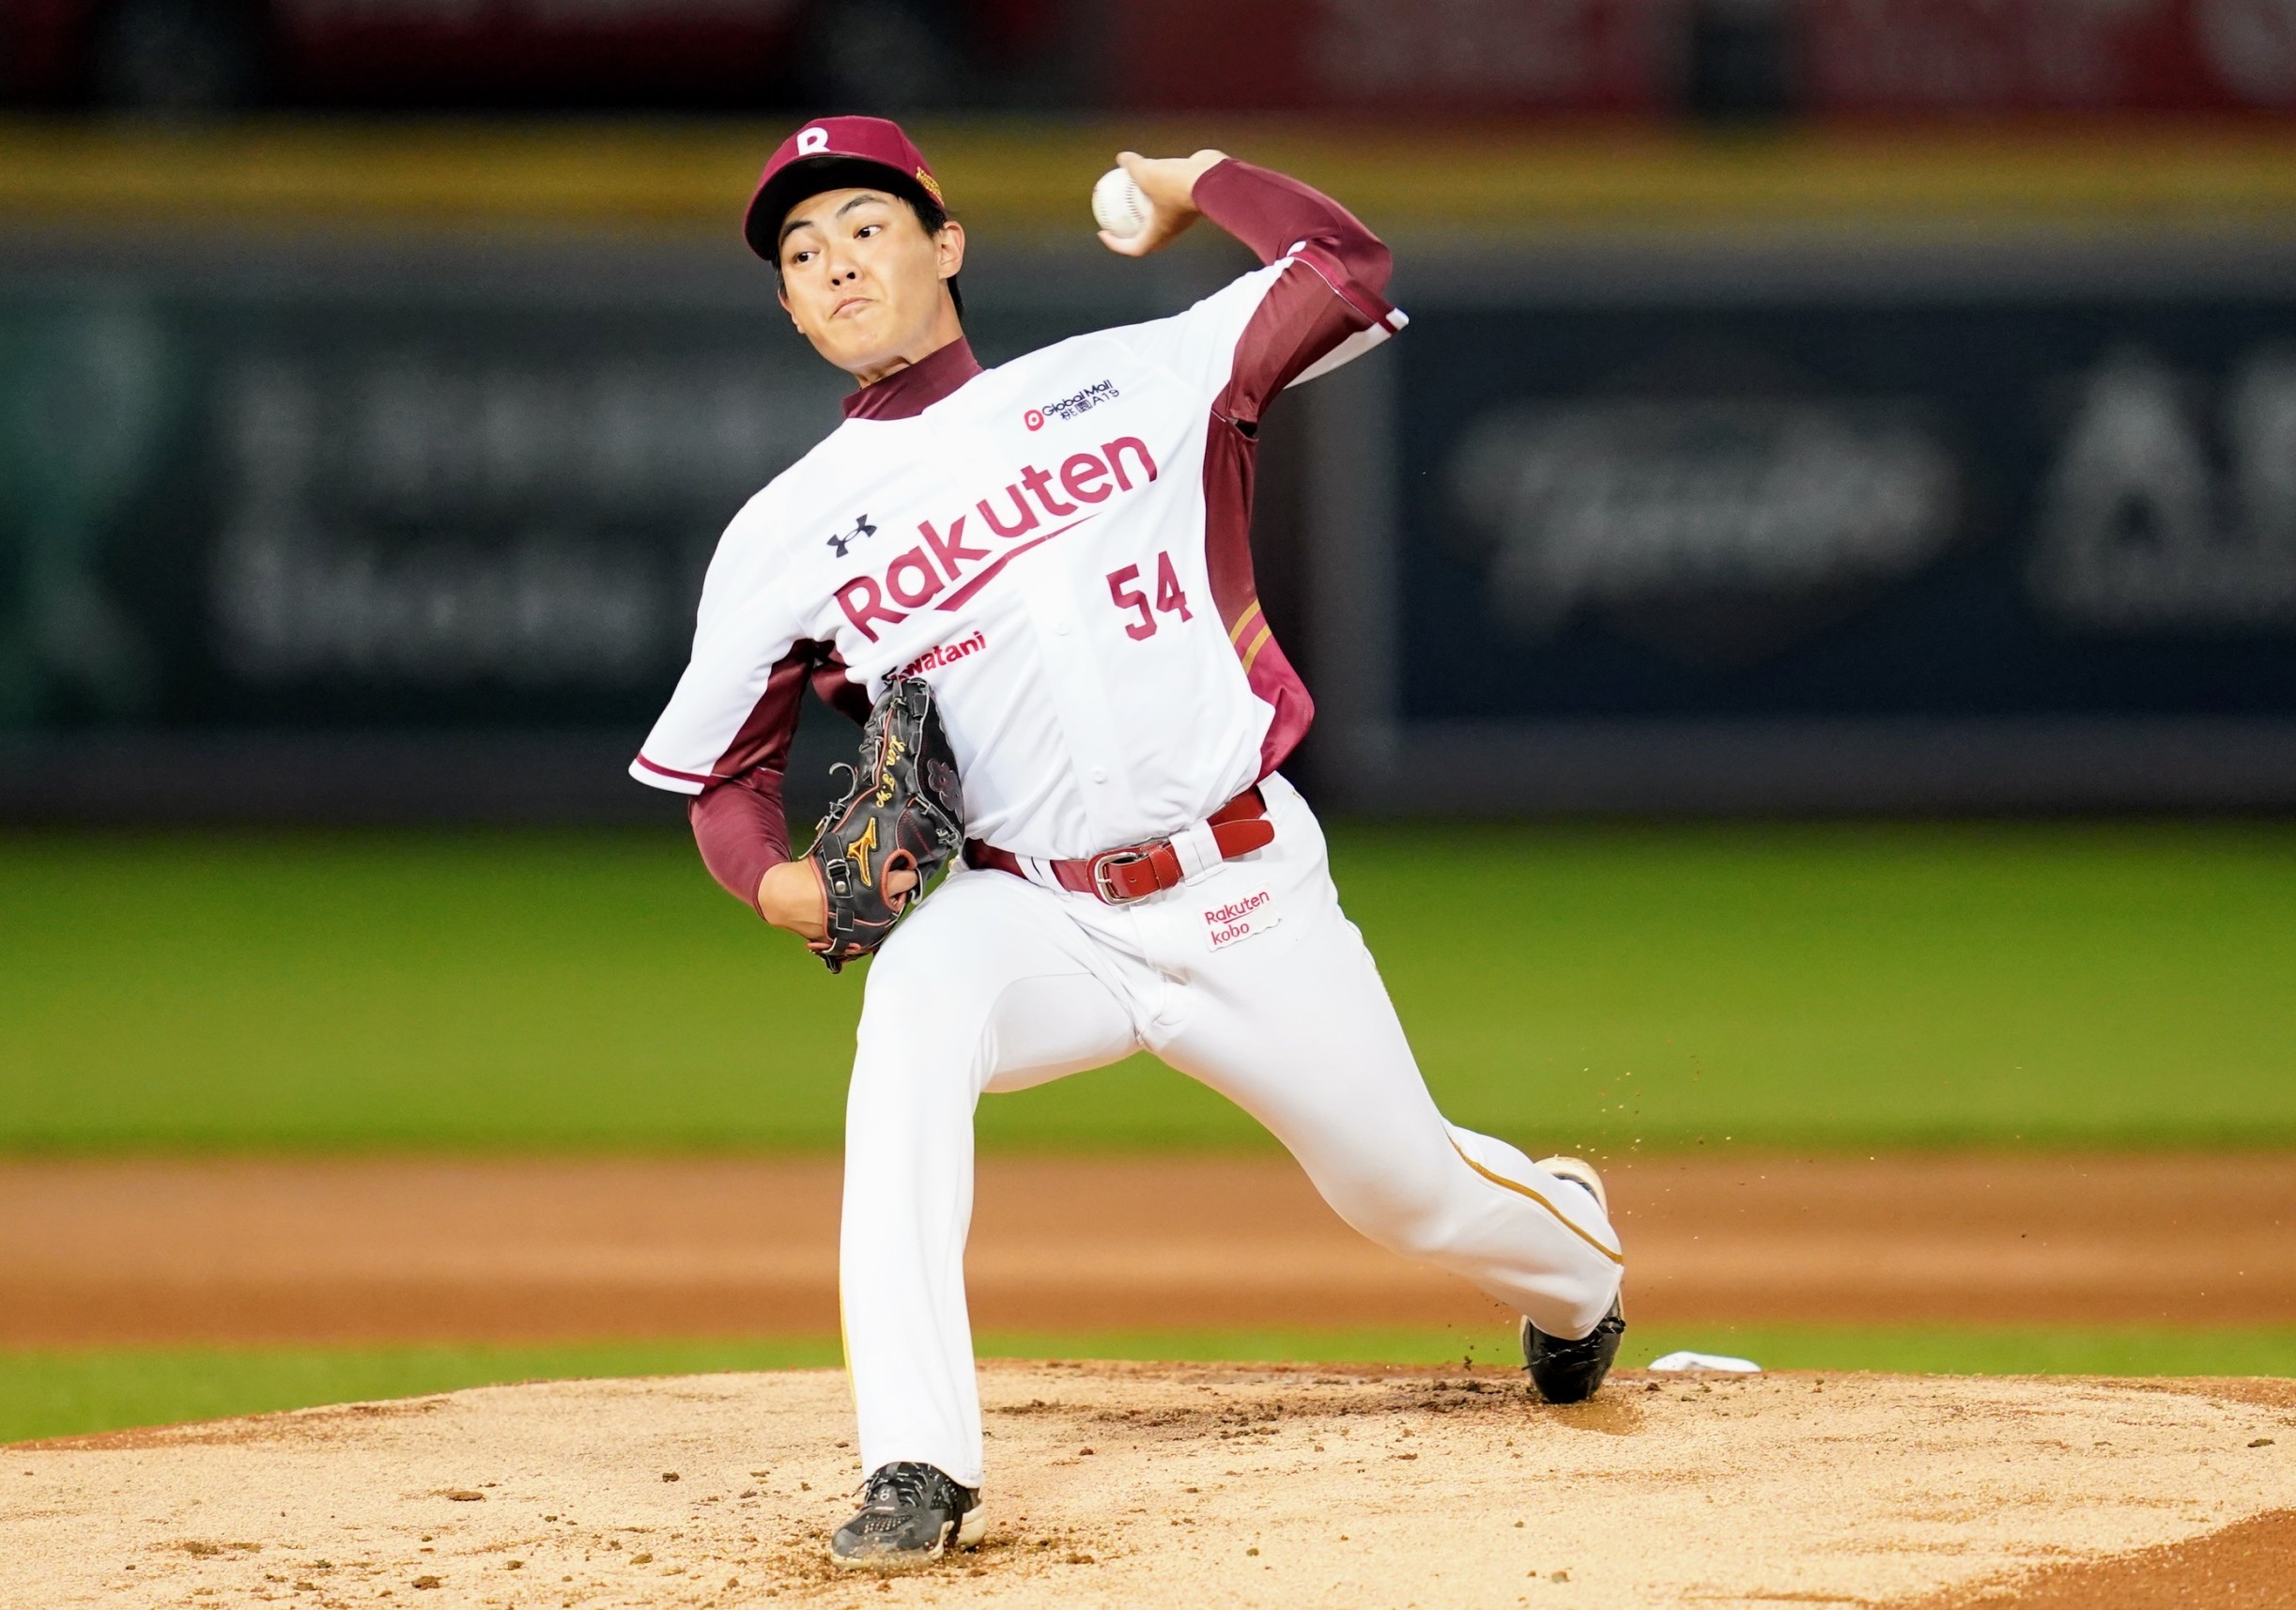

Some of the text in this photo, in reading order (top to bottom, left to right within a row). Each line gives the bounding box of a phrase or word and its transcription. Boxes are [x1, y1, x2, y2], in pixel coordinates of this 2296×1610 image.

[796, 127, 831, 156] R
[1041, 379, 1114, 416] Global Mall
[833, 436, 1158, 643] Rakuten
[1106, 550, 1194, 641] 54
[890, 630, 987, 680] watani
[1204, 891, 1271, 925] Rakuten
[1210, 923, 1250, 946] kobo
